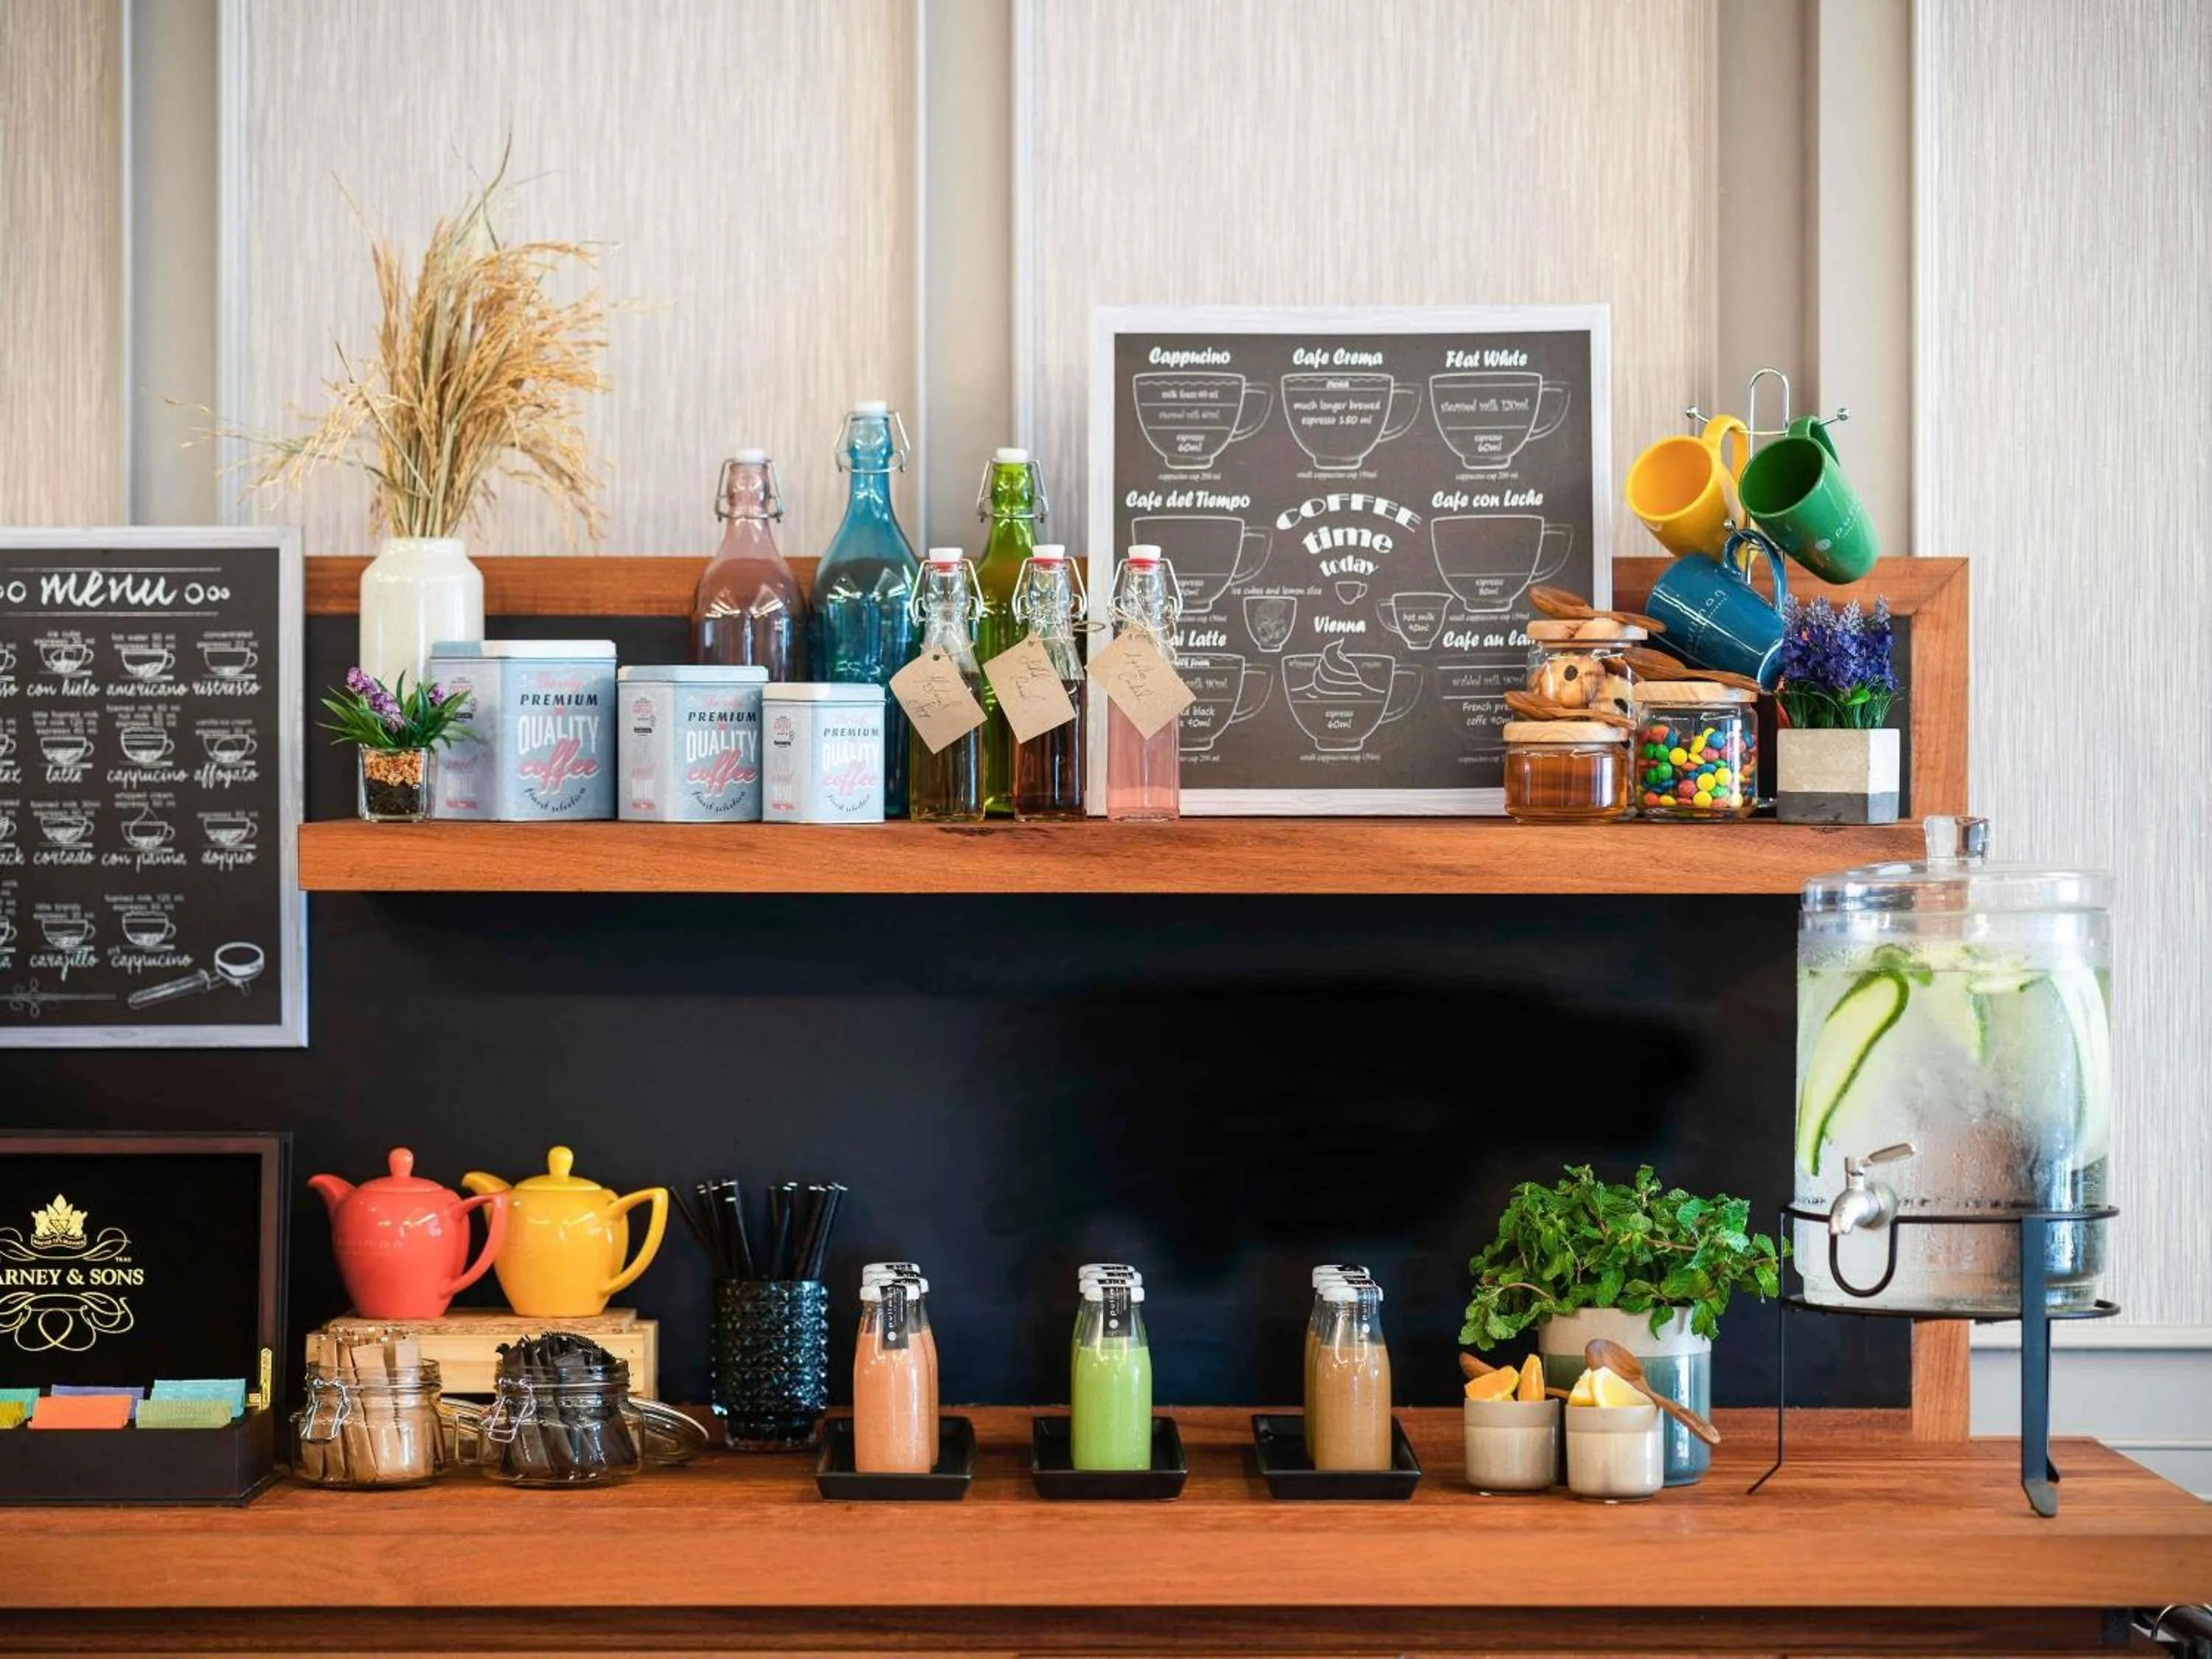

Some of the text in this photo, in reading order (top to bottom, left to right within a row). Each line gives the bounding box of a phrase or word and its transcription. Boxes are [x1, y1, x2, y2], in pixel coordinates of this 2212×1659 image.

[1149, 347, 1231, 368] Cappucino
[1293, 347, 1383, 369] Cafe Crema
[1445, 349, 1528, 368] Flat White
[1125, 489, 1251, 511] Cafe del Tiempo
[1431, 489, 1543, 511] Cafe con Leche
[1276, 493, 1422, 533] COFFEE
[1301, 526, 1394, 554] time
[1319, 554, 1380, 577] today
[41, 571, 178, 608] menu
[1314, 616, 1366, 633] Vienna
[1188, 630, 1228, 647] Latte
[1442, 630, 1480, 650] Cafe
[1483, 634, 1503, 648] au
[27, 683, 58, 697] con
[61, 678, 100, 697] hielo
[106, 682, 189, 697] americano
[519, 693, 599, 706] PREMIUM
[1462, 701, 1492, 712] French
[688, 712, 757, 723] PREMIUM
[518, 714, 599, 756] QUALITY
[823, 727, 880, 737] PREMIUM
[686, 729, 757, 764] QUALITY
[46, 764, 83, 783] latte
[193, 762, 260, 789] affogato
[517, 738, 601, 795] coffee
[686, 749, 758, 799] coffee
[106, 769, 189, 790] cappucino
[101, 853, 132, 866] con
[0, 1268, 145, 1286] RNEY & SONS
